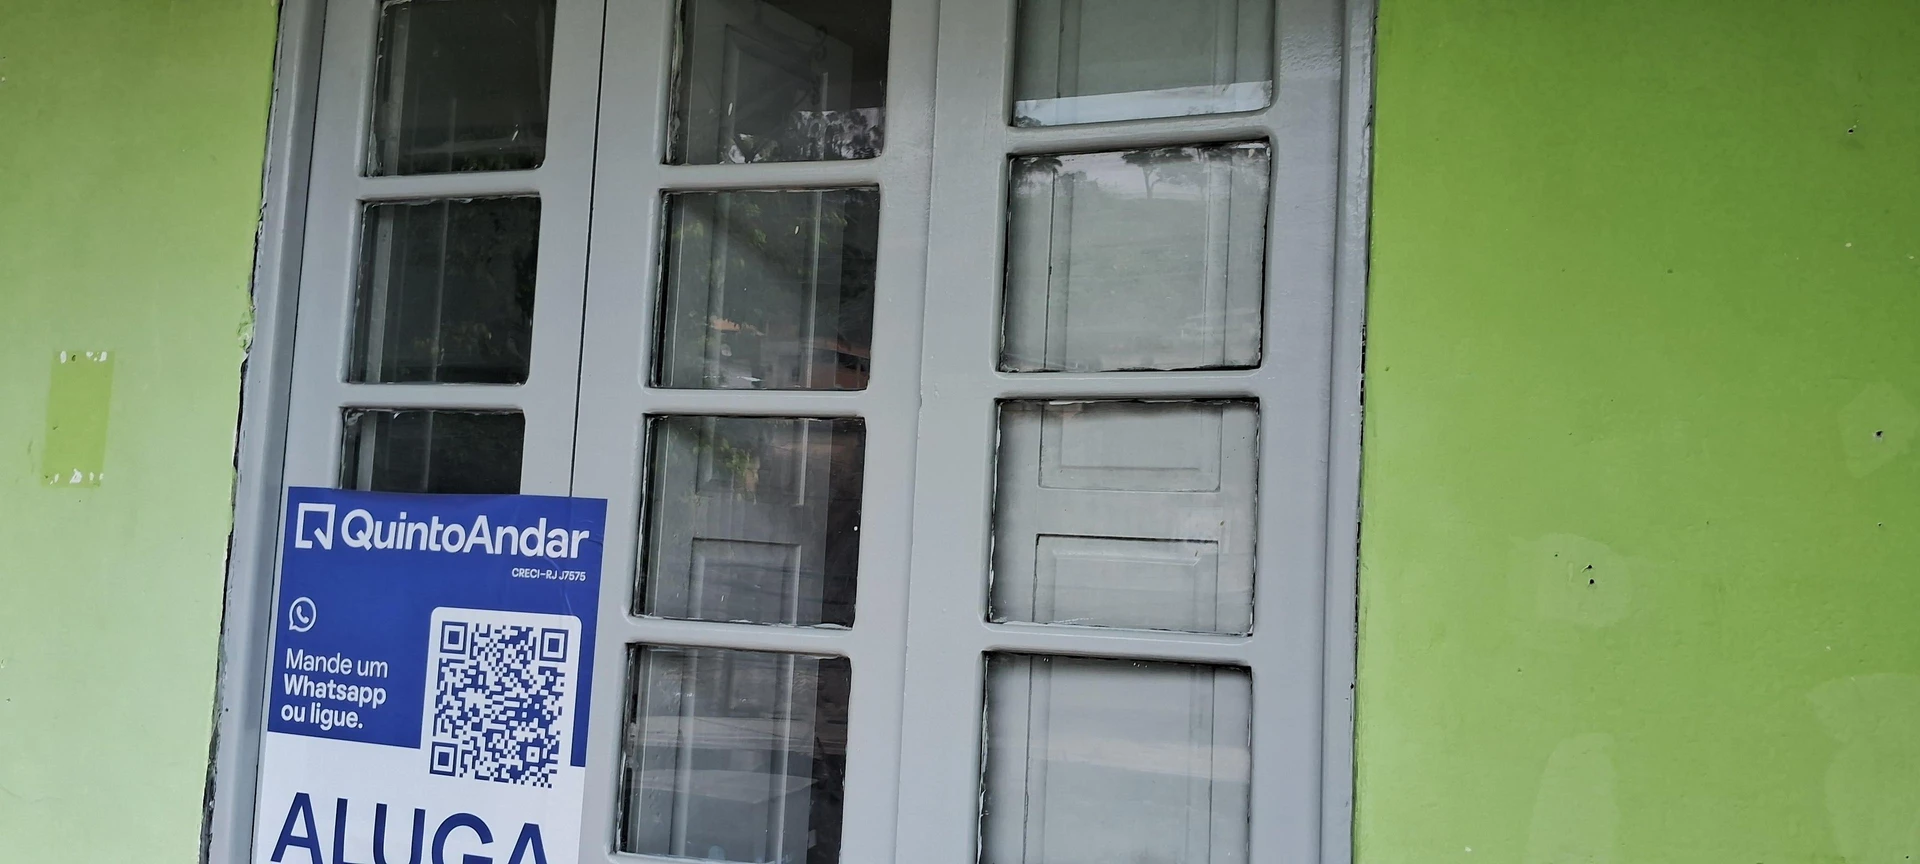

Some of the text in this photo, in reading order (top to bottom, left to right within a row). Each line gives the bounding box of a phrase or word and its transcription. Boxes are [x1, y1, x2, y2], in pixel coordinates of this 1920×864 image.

[341, 508, 590, 559] QuintoAndar
[511, 567, 587, 582] CRECI-RJ J7575
[286, 648, 389, 678] Mande um
[283, 673, 387, 709] Whatsapp
[281, 702, 364, 731] ou ligue.
[270, 791, 551, 864] ALUGA
